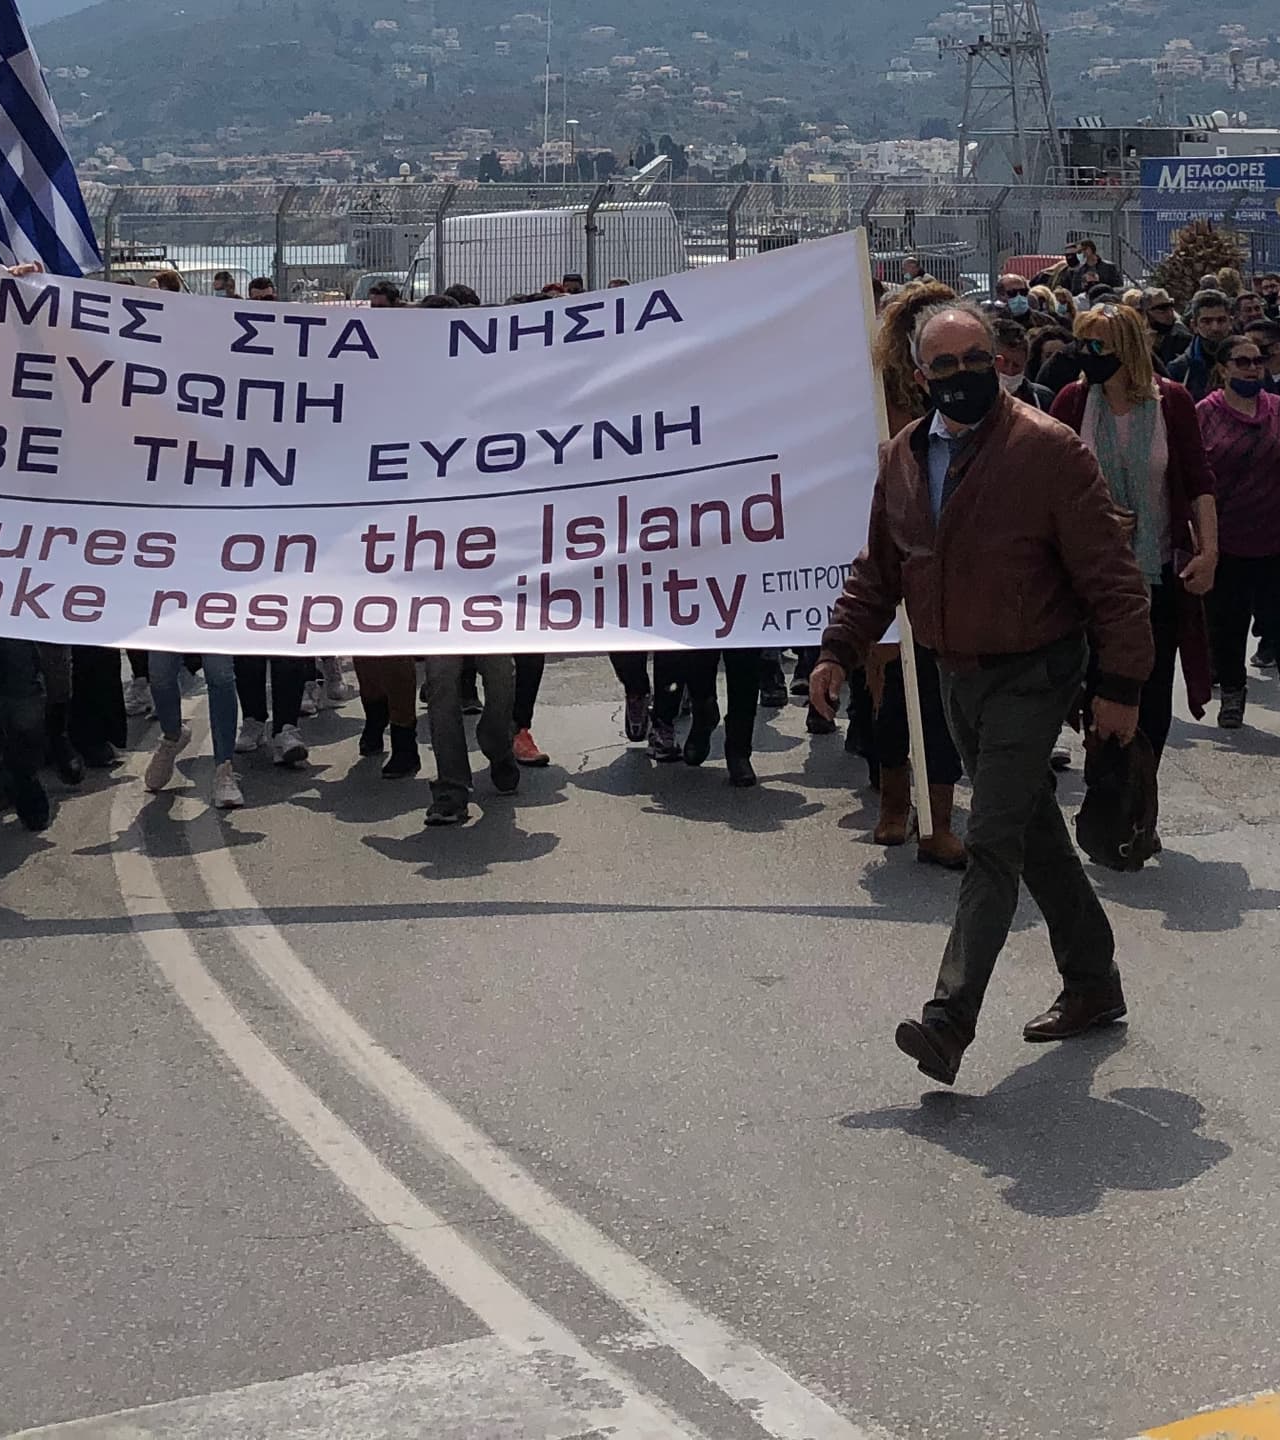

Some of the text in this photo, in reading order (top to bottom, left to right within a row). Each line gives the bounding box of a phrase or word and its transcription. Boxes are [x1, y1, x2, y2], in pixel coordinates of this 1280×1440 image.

[230, 312, 379, 359] ΣΤΑ
[449, 290, 683, 357] ΝΗΣΙΑ
[11, 352, 344, 423] ΕΥΡΩΠΗ
[134, 436, 296, 487] ΤΗΝ
[369, 406, 702, 482] ΕΥΘΥΝΗ
[220, 533, 317, 573] on
[361, 515, 496, 574] the
[542, 474, 784, 564] Island
[149, 562, 747, 644] responsibility
